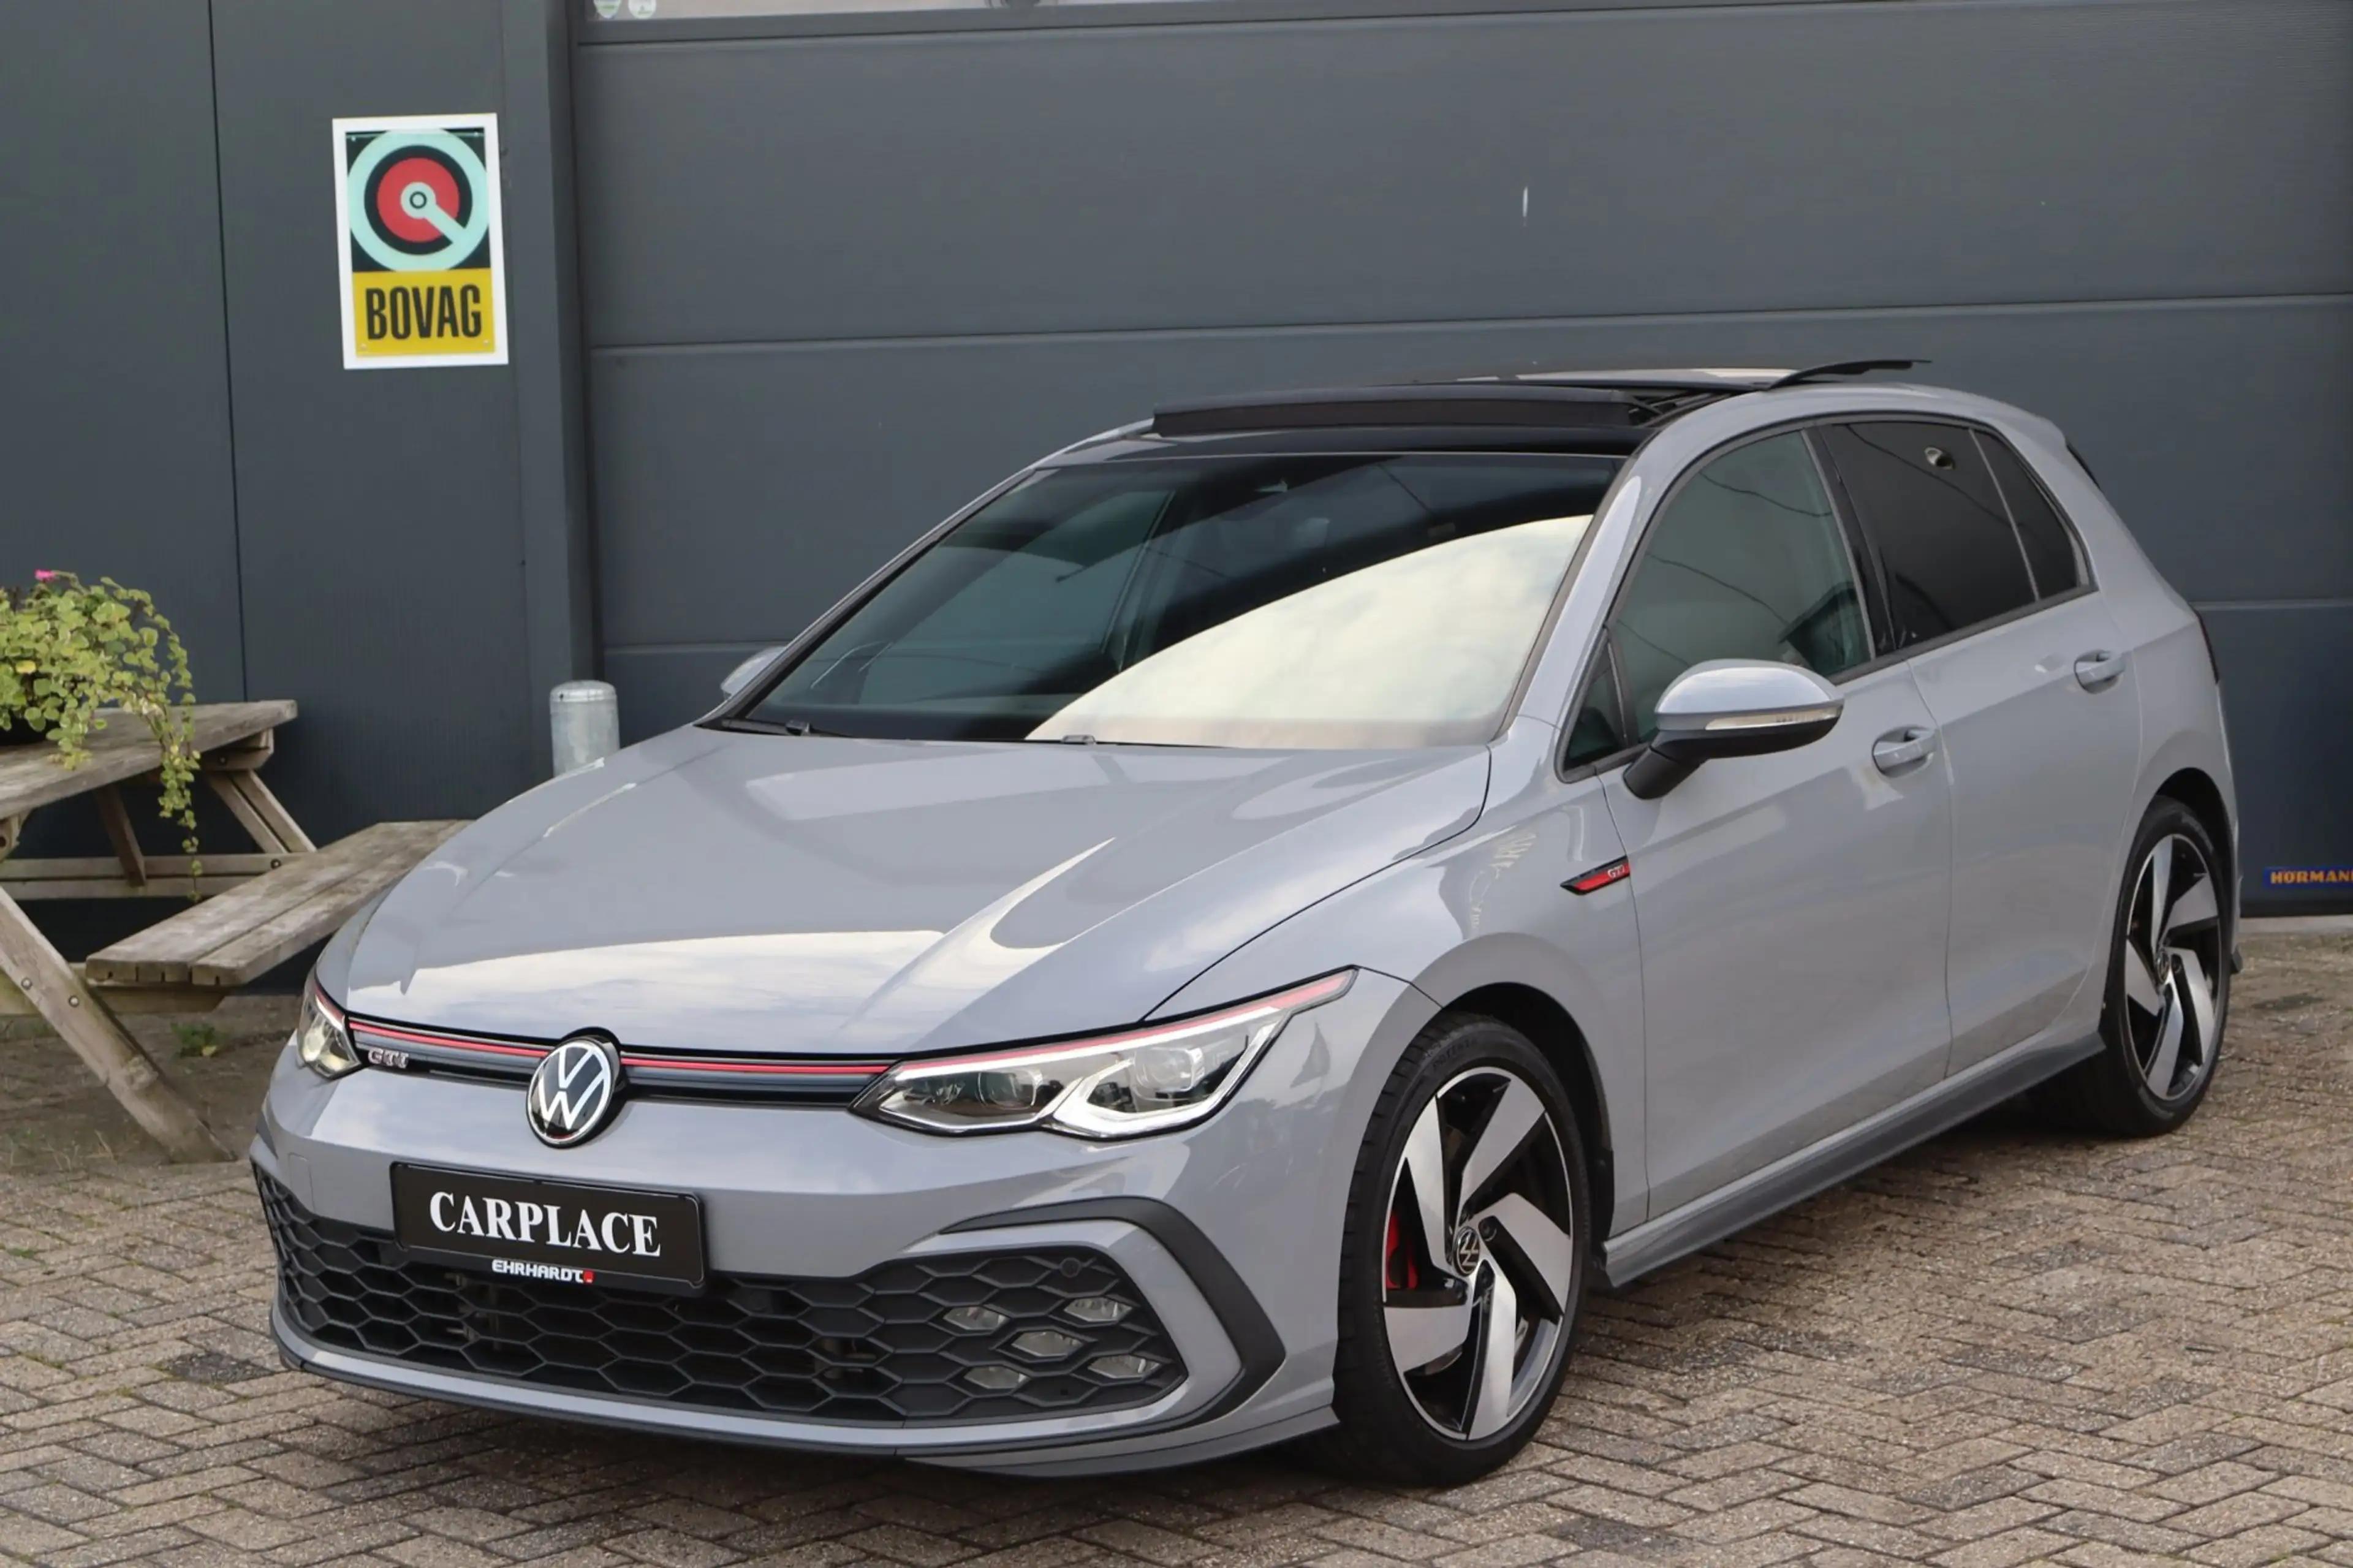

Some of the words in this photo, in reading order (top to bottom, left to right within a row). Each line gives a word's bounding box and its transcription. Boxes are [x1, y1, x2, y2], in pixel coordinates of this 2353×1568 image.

[365, 284, 482, 341] BOVAG
[368, 1047, 409, 1069] GTI
[430, 1192, 661, 1257] CARPLACE
[491, 1259, 584, 1284] EHRHARDT
